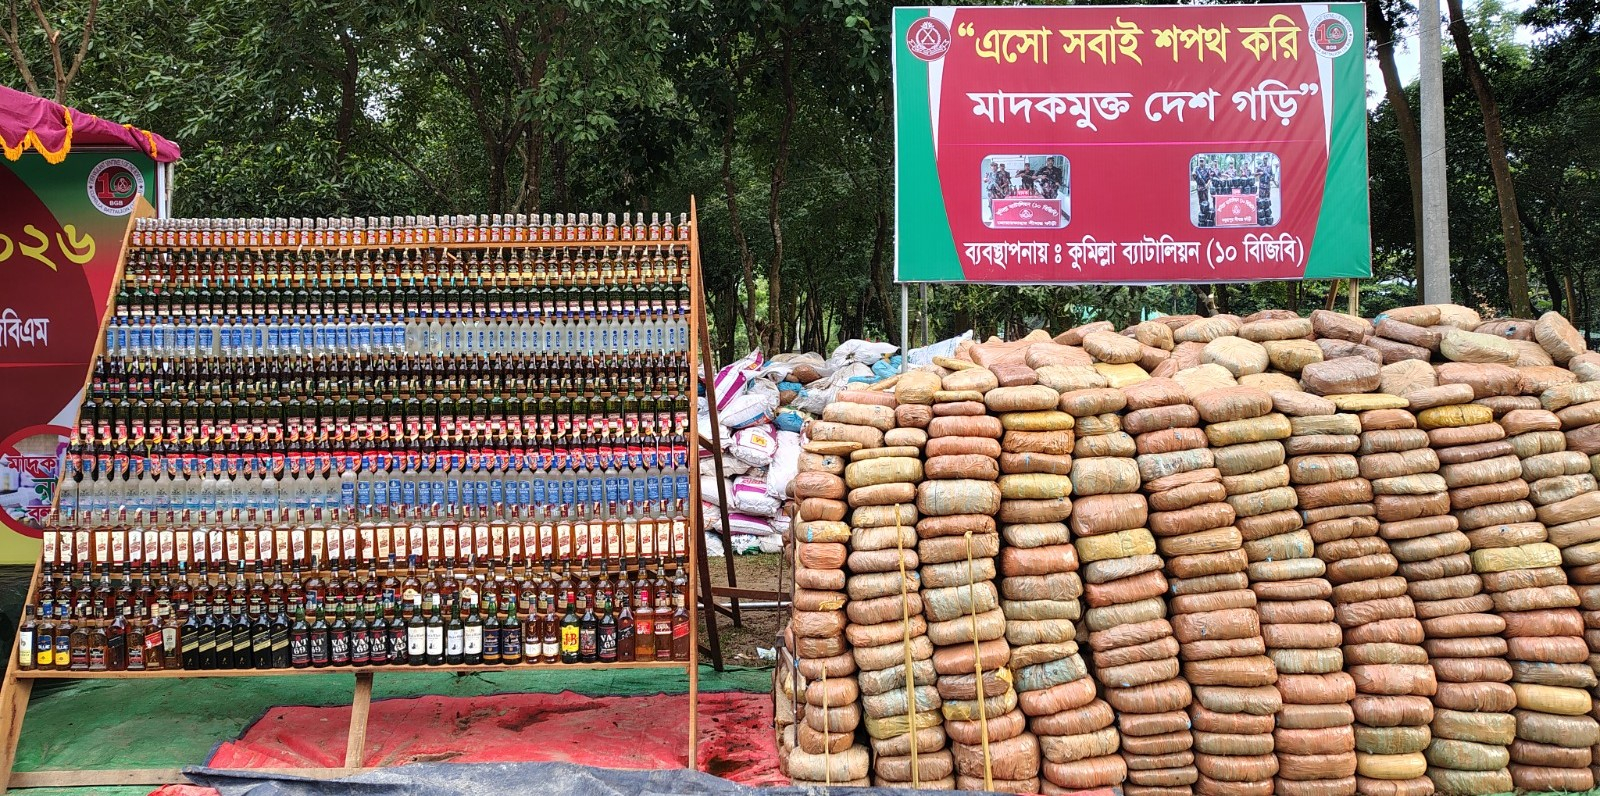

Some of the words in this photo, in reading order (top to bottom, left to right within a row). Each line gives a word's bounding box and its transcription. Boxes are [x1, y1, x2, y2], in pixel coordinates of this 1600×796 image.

[1062, 16, 1142, 65] সবাই
[1153, 23, 1230, 63] শপথ
[1237, 14, 1302, 63] করি
[966, 89, 1133, 131] মাদকমুক্ত
[1144, 87, 1221, 122] দেশ
[964, 239, 1049, 270] ব্যবস্থাপনায়
[1068, 234, 1116, 270] কুমিল্লা
[1120, 234, 1200, 266] ব্যাটালিয়ন
[1207, 237, 1236, 268] (১০
[1242, 233, 1305, 266] বিজিবি)
[0, 308, 50, 349] বিএম
[6, 455, 57, 475] মাদক
[604, 640, 616, 649] 69
